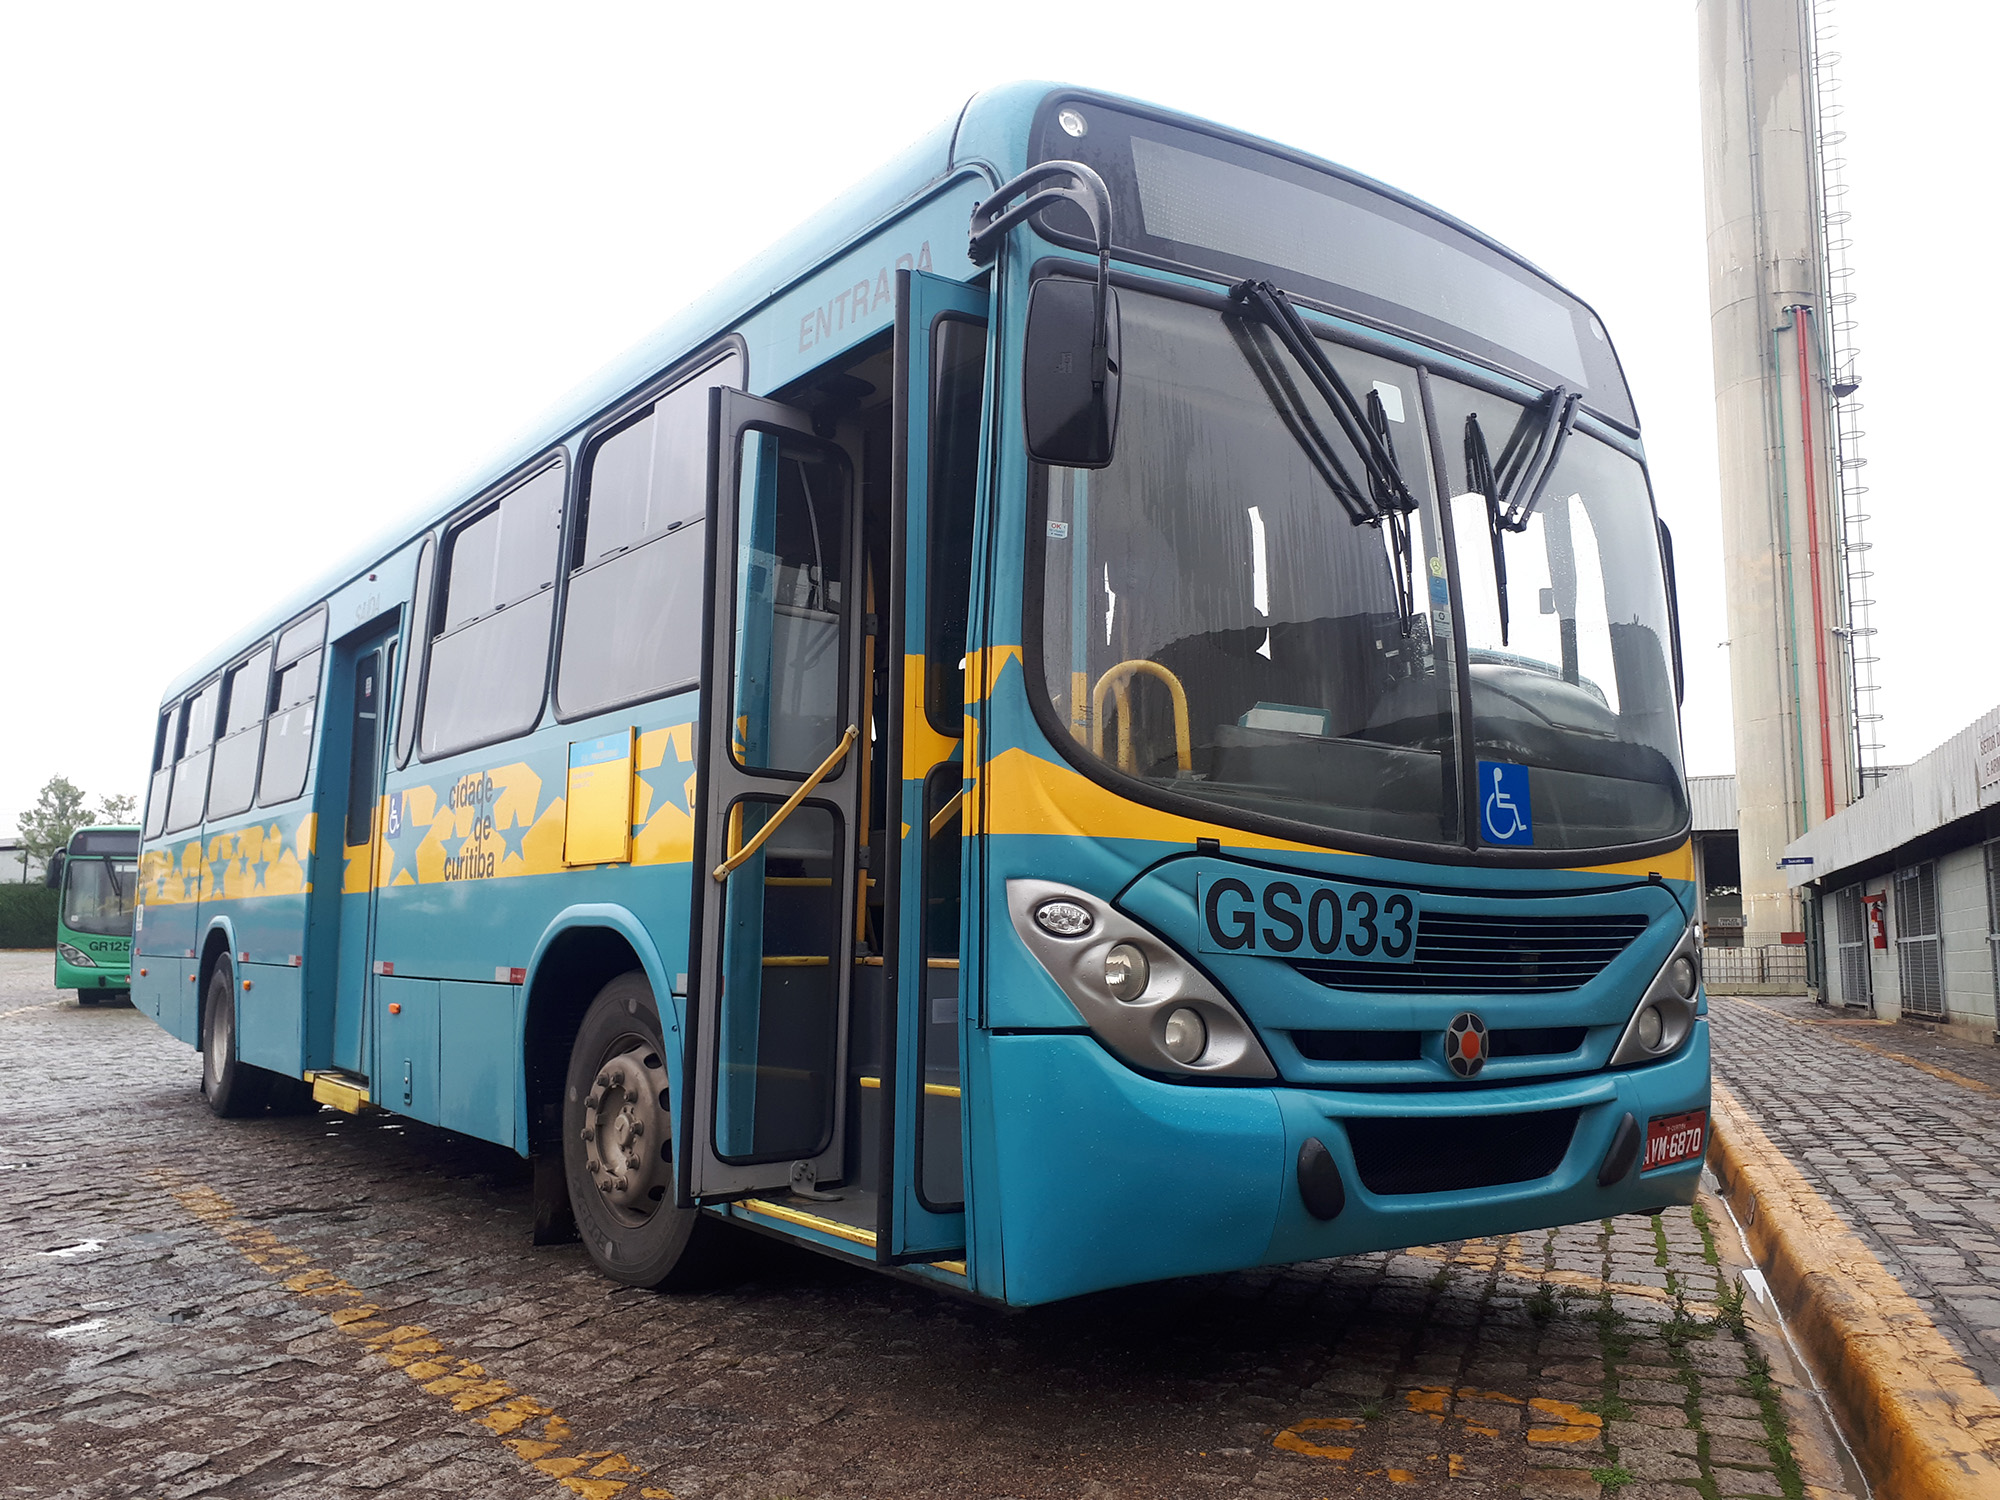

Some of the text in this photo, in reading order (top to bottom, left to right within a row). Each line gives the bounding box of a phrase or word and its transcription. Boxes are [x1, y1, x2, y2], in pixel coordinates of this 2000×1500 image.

[449, 771, 493, 810] cidade
[474, 807, 492, 842] de
[444, 845, 495, 881] curitiba
[1205, 877, 1413, 958] GS033
